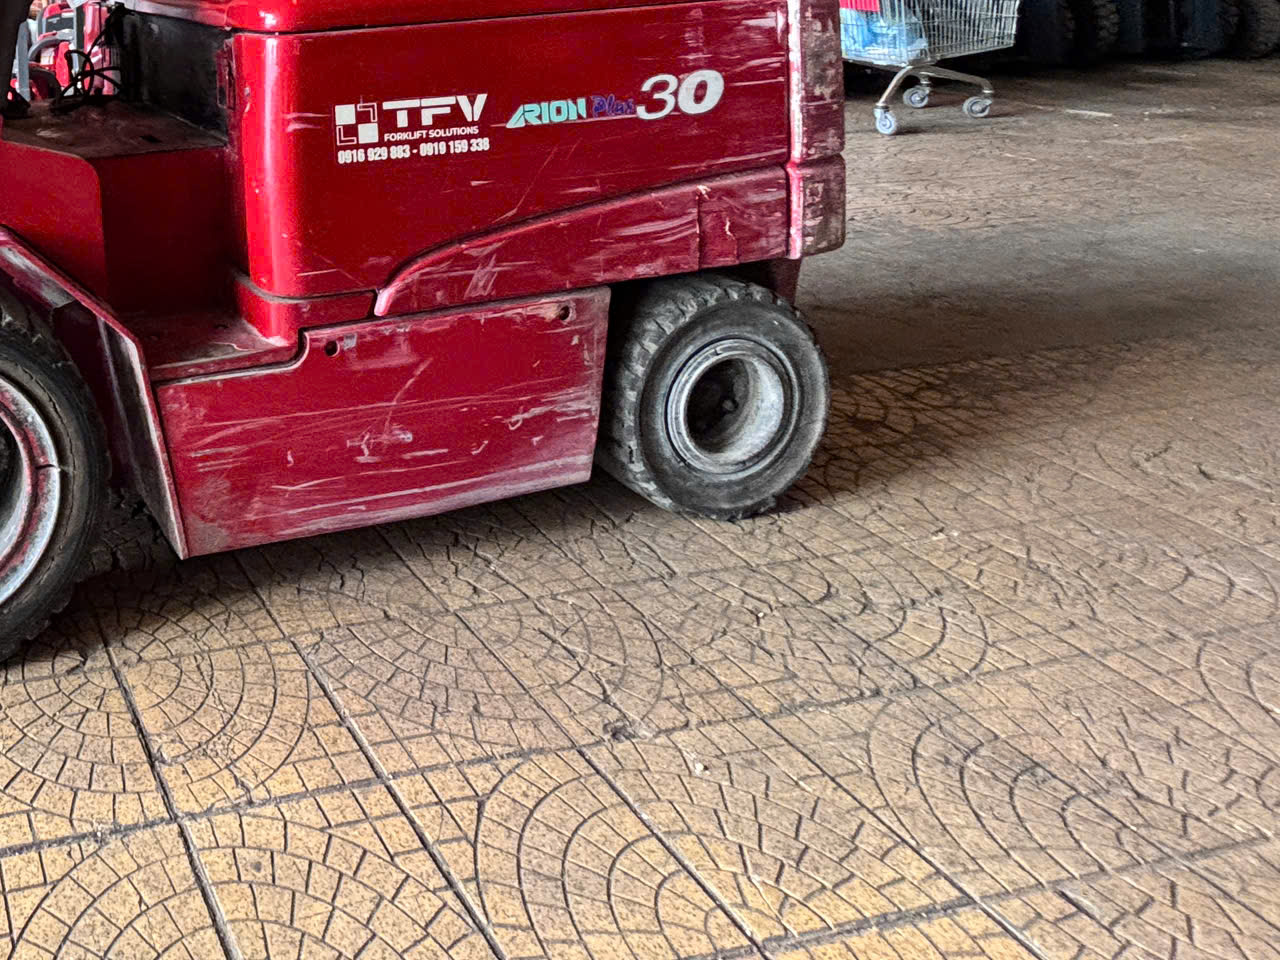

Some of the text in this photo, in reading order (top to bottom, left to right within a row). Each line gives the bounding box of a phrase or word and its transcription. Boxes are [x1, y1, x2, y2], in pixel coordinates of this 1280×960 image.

[382, 93, 488, 128] TFV
[505, 97, 587, 128] ARION
[636, 69, 725, 120] 30
[384, 126, 480, 142] FORKLIFT SOLUTIONS
[337, 149, 366, 164] 0916
[367, 147, 388, 161] 929
[447, 139, 468, 154] 159
